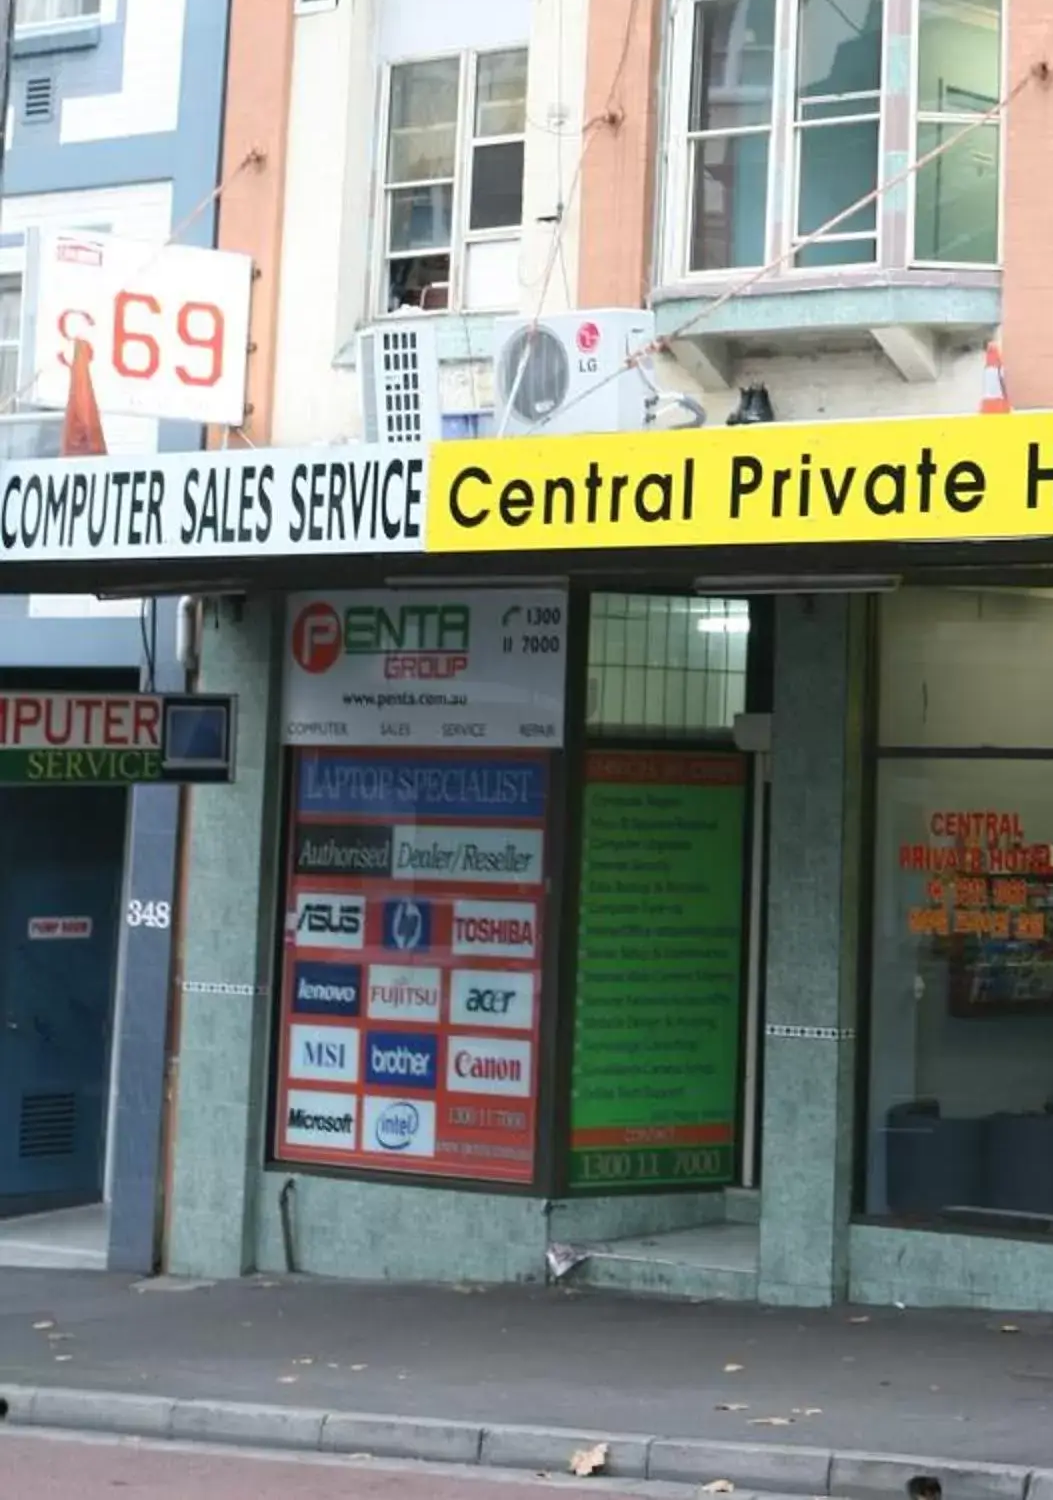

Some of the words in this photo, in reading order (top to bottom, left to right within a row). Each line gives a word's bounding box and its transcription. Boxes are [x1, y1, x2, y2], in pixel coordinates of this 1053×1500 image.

[579, 358, 598, 372] LG
[449, 457, 694, 528] Central
[729, 448, 986, 520] Private
[1, 471, 165, 549] COMPUTER
[181, 464, 275, 544] SALES
[289, 458, 423, 542] SERVICE
[526, 606, 562, 625] 1300
[293, 602, 470, 673] PENTA
[384, 656, 468, 680] GROUP
[343, 691, 468, 708] www.penta.com.au
[0, 697, 161, 746] PUTER
[287, 720, 348, 737] COMPUTER
[380, 721, 411, 737] SALES
[441, 722, 487, 738] SERVICE
[27, 751, 161, 780] SERVICE
[304, 762, 395, 800] LAPTOP
[399, 766, 533, 803] SPECIALIST
[930, 812, 1024, 840] CENTRAL
[299, 837, 390, 870] Authorised
[398, 842, 534, 873] Dealer/Reseller
[126, 900, 170, 928] 348
[298, 904, 361, 934] ASUS
[456, 916, 532, 945] TOSHIBA
[297, 977, 356, 1003] lenovo
[370, 982, 438, 1009] FUJITSU
[466, 988, 516, 1013] acer
[303, 1040, 345, 1069] MSI
[371, 1045, 431, 1076] brother
[454, 1050, 522, 1081] Canon
[288, 1108, 353, 1134] Microsoft
[380, 1115, 416, 1137] intel
[581, 1153, 631, 1179] 1300
[673, 1150, 721, 1176] 7000
